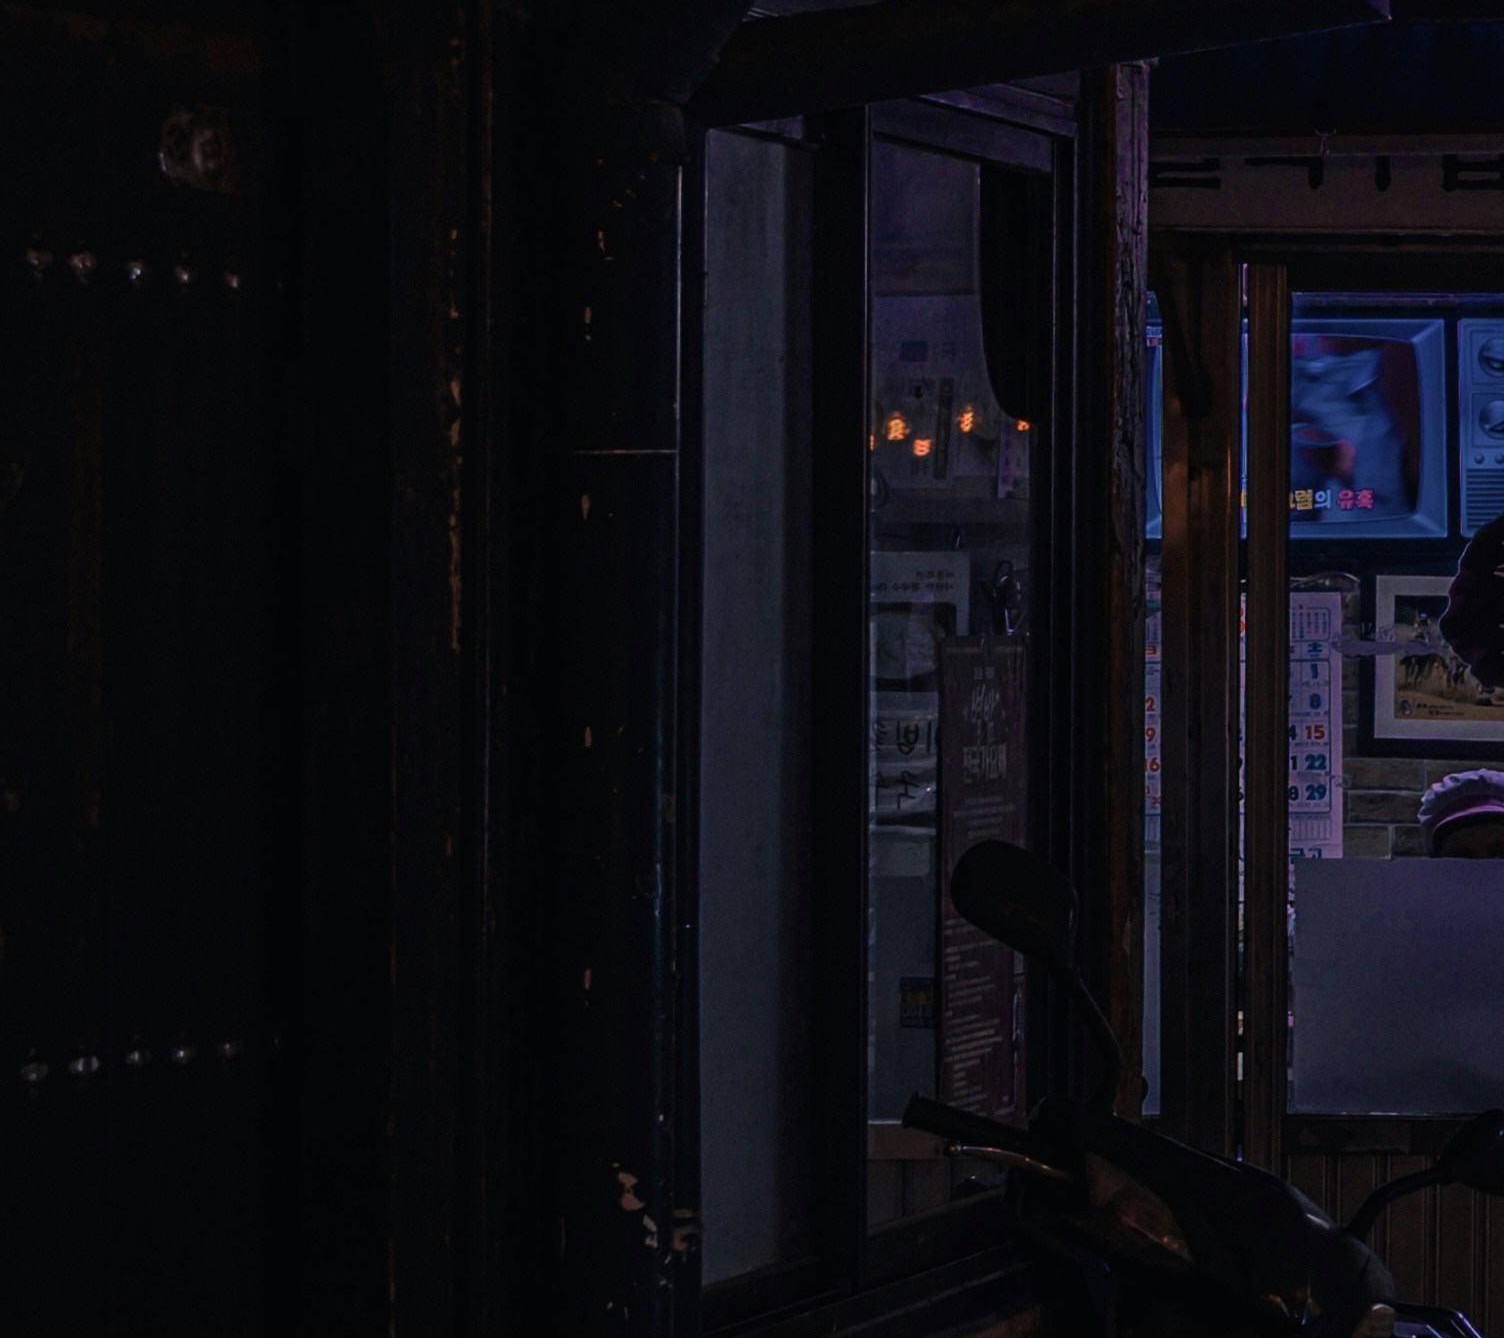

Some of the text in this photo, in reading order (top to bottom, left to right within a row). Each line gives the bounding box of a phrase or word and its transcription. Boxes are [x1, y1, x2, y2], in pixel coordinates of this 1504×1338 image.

[1310, 663, 1320, 680] 1
[1309, 693, 1322, 709] 8
[1304, 724, 1325, 741] 15
[1304, 753, 1328, 771] 22
[1305, 783, 1328, 801] 29
